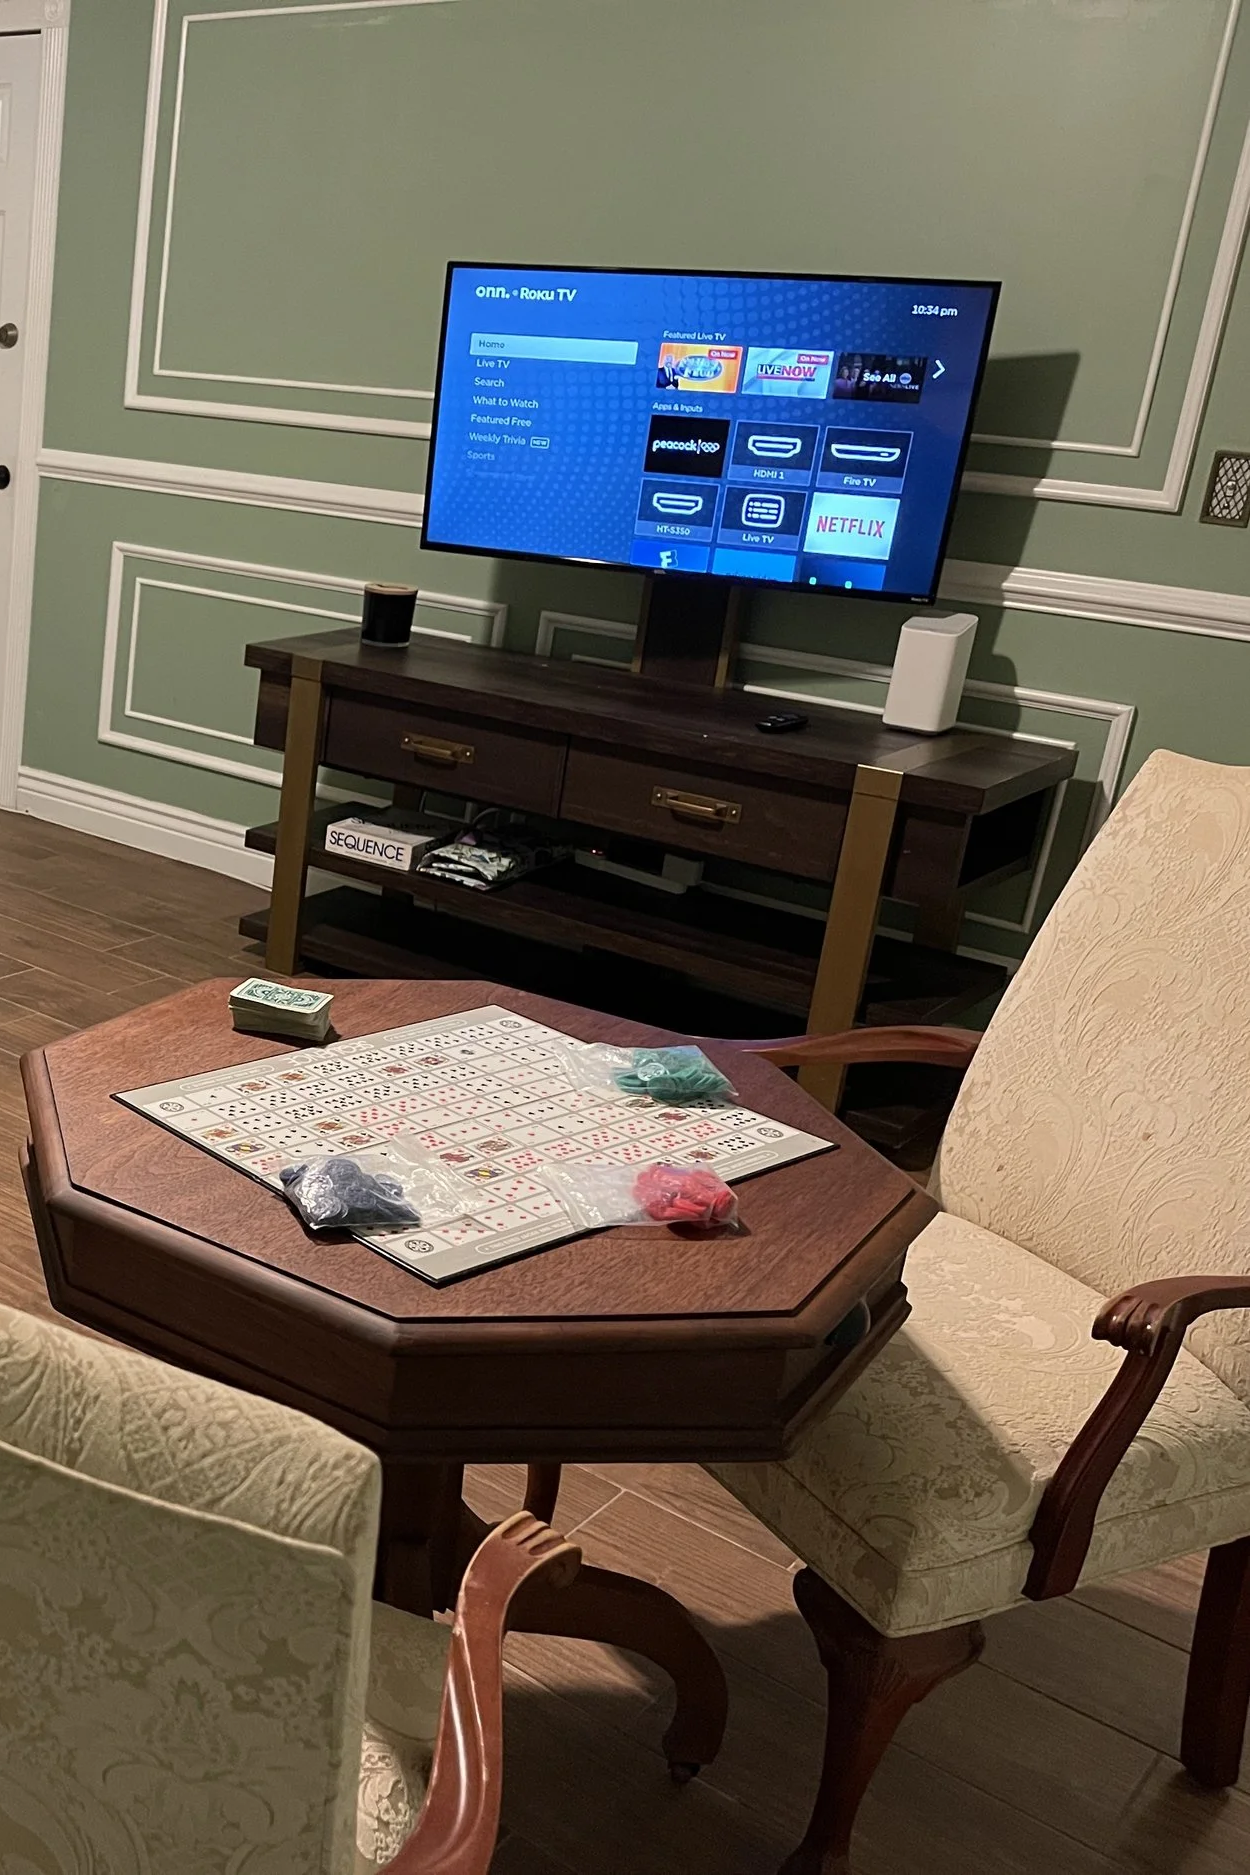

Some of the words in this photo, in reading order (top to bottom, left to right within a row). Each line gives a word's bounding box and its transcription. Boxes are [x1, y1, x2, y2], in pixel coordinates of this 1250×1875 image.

[475, 286, 510, 299] onn.
[519, 287, 555, 301] Roku
[556, 289, 577, 302] TV
[911, 304, 939, 316] 10:34
[940, 307, 958, 317] pm
[663, 330, 696, 340] Featured
[697, 332, 713, 341] Live
[714, 332, 727, 342] TV
[478, 340, 506, 349] Home
[476, 358, 495, 368] Live
[496, 359, 511, 369] TV
[474, 377, 505, 388] Search
[862, 372, 882, 382] See
[882, 373, 897, 383] All
[472, 395, 496, 405] What
[498, 397, 508, 407] to
[510, 398, 539, 409] Watch
[652, 401, 672, 411] Apps
[672, 403, 680, 411] &
[680, 403, 703, 413] Inputs
[470, 414, 510, 425] Featured
[511, 417, 532, 427] Free
[469, 432, 501, 444] Weekly
[502, 434, 527, 445] Trivia
[652, 439, 697, 452] peacock
[467, 450, 495, 461] Sports
[753, 469, 777, 479] HDMI
[779, 471, 785, 480] 1
[843, 476, 861, 486] Fire
[862, 478, 877, 487] TV
[656, 525, 691, 536] HT-S350
[816, 515, 885, 538] NETFLIX
[742, 533, 760, 543] Live
[761, 535, 775, 544] TV
[329, 831, 405, 862] SEQUENCE
